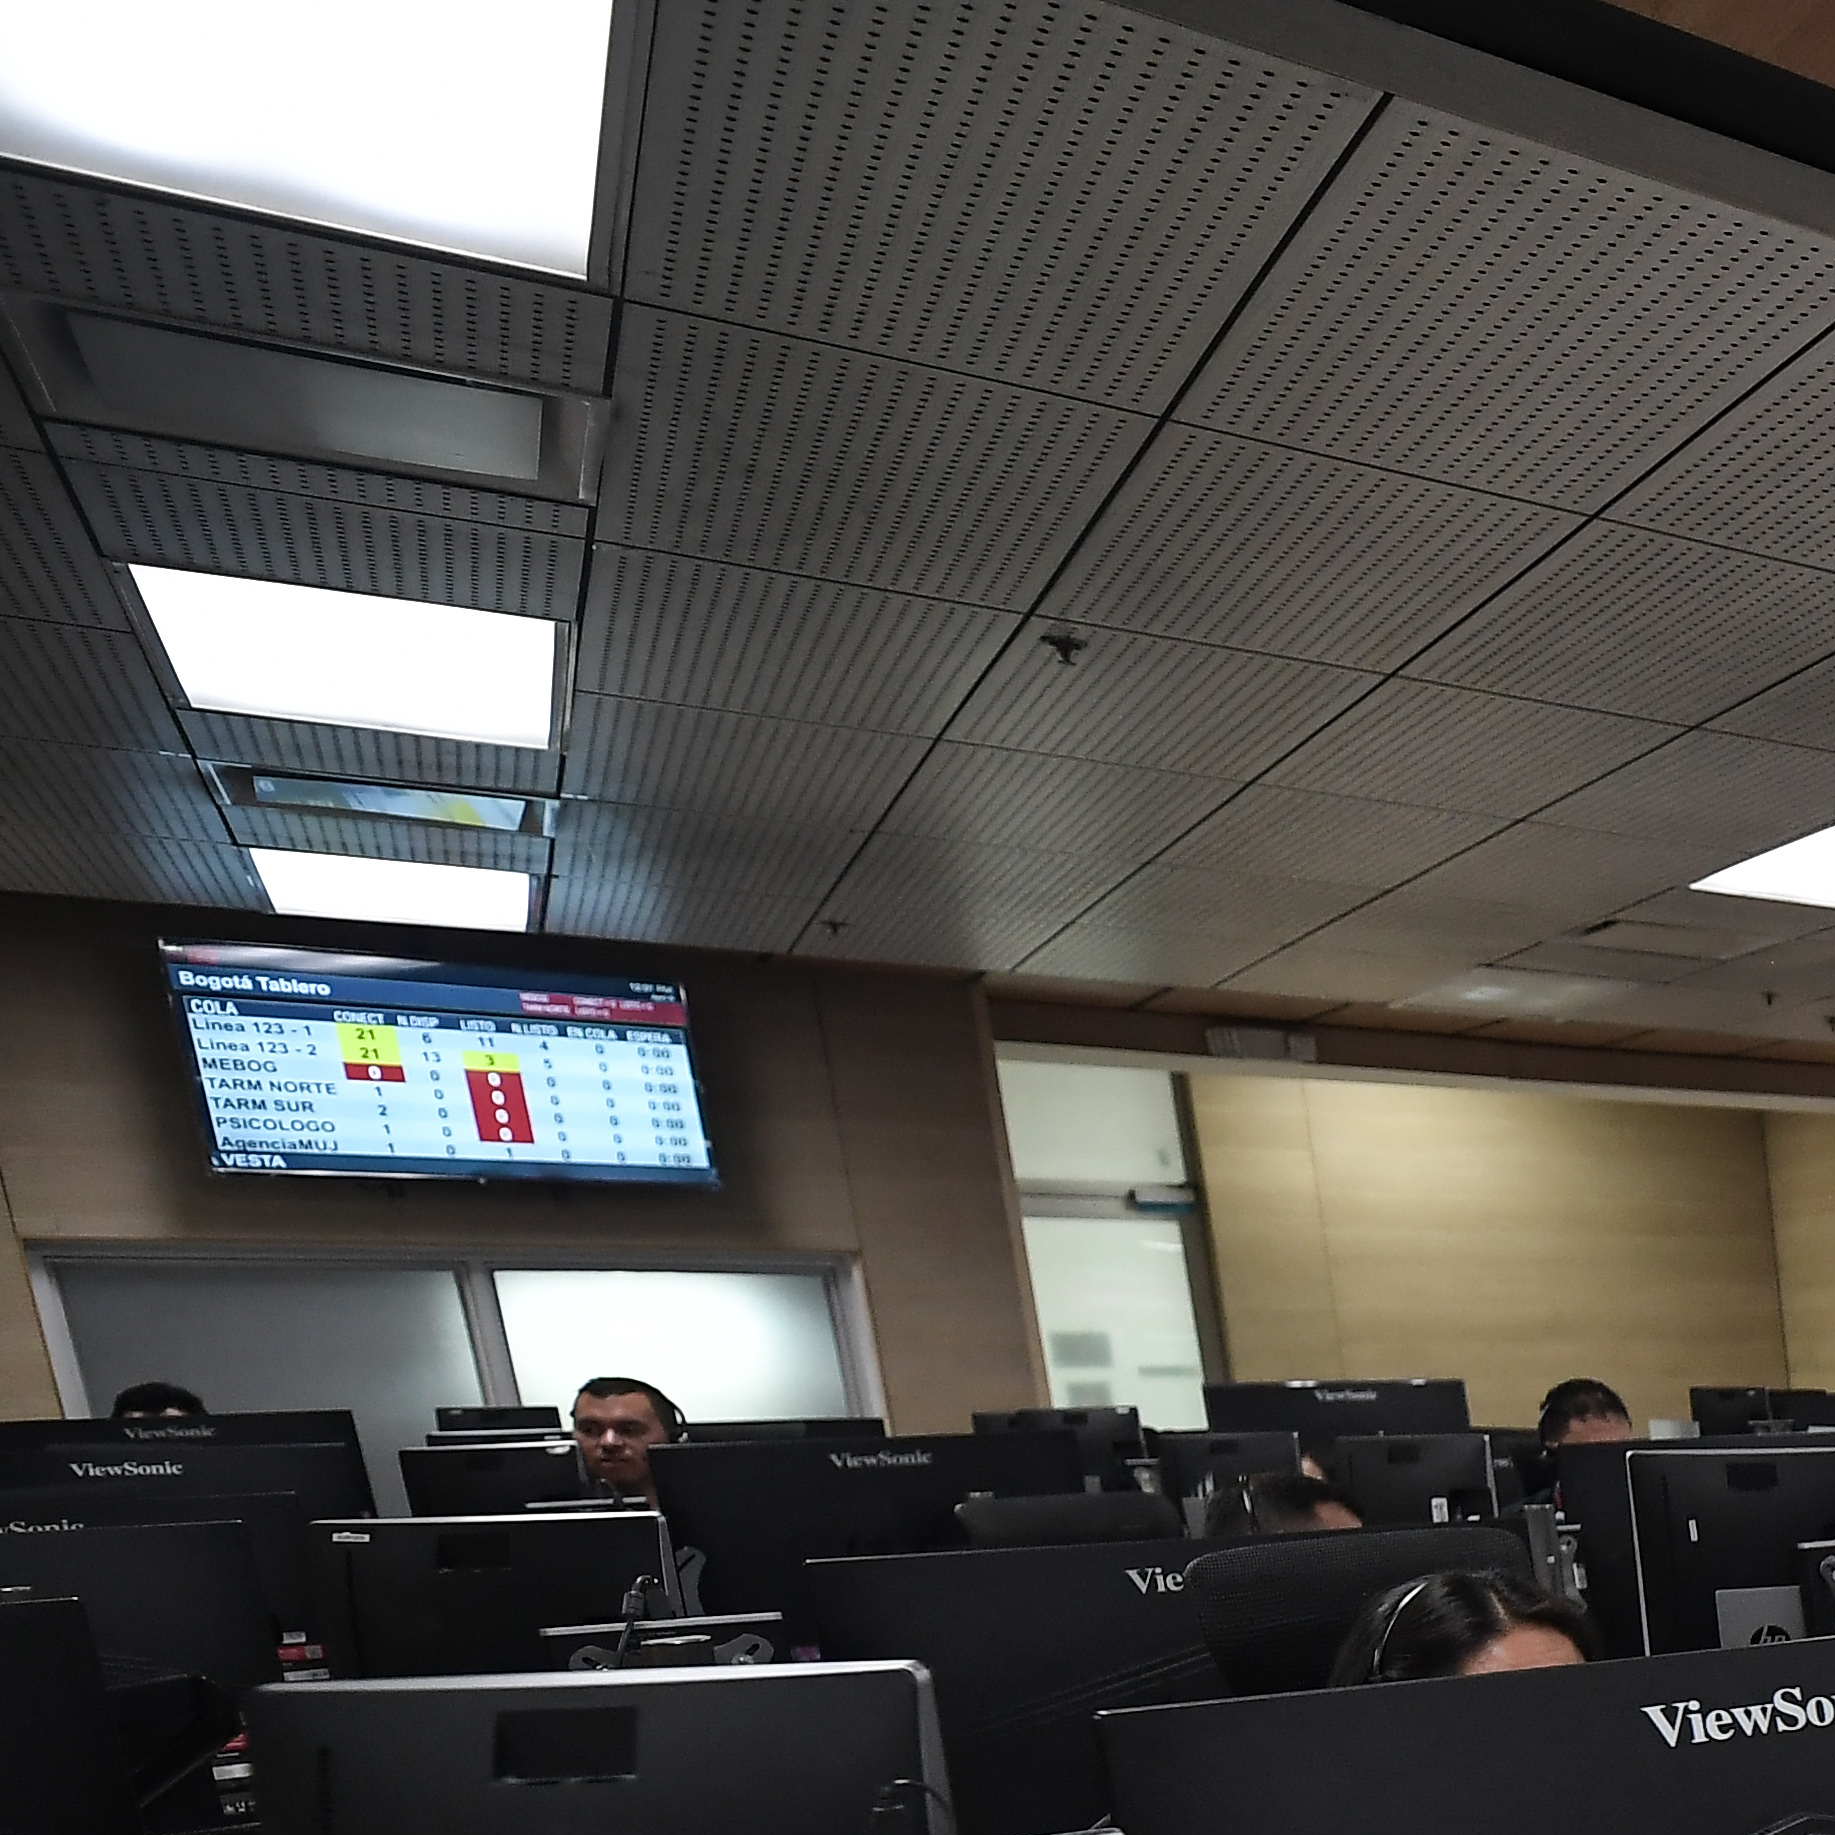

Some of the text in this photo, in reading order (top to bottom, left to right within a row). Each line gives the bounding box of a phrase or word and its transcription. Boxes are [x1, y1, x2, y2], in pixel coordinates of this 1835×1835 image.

[178, 969, 331, 996] Bogotá Tablero
[190, 999, 239, 1016] COLA
[253, 1021, 285, 1035] 123
[355, 1027, 376, 1041] 21
[258, 1041, 290, 1055] 123
[306, 1044, 318, 1056] 2
[202, 1057, 278, 1073] MEBOG
[205, 1076, 262, 1091] TARM
[270, 1080, 338, 1096] NORTE
[210, 1096, 267, 1111] TARM
[274, 1099, 315, 1114] SUR
[215, 1116, 336, 1133] PSICOLOGO
[829, 1449, 933, 1469] ViewSonic
[69, 1459, 184, 1478] ViewSonic
